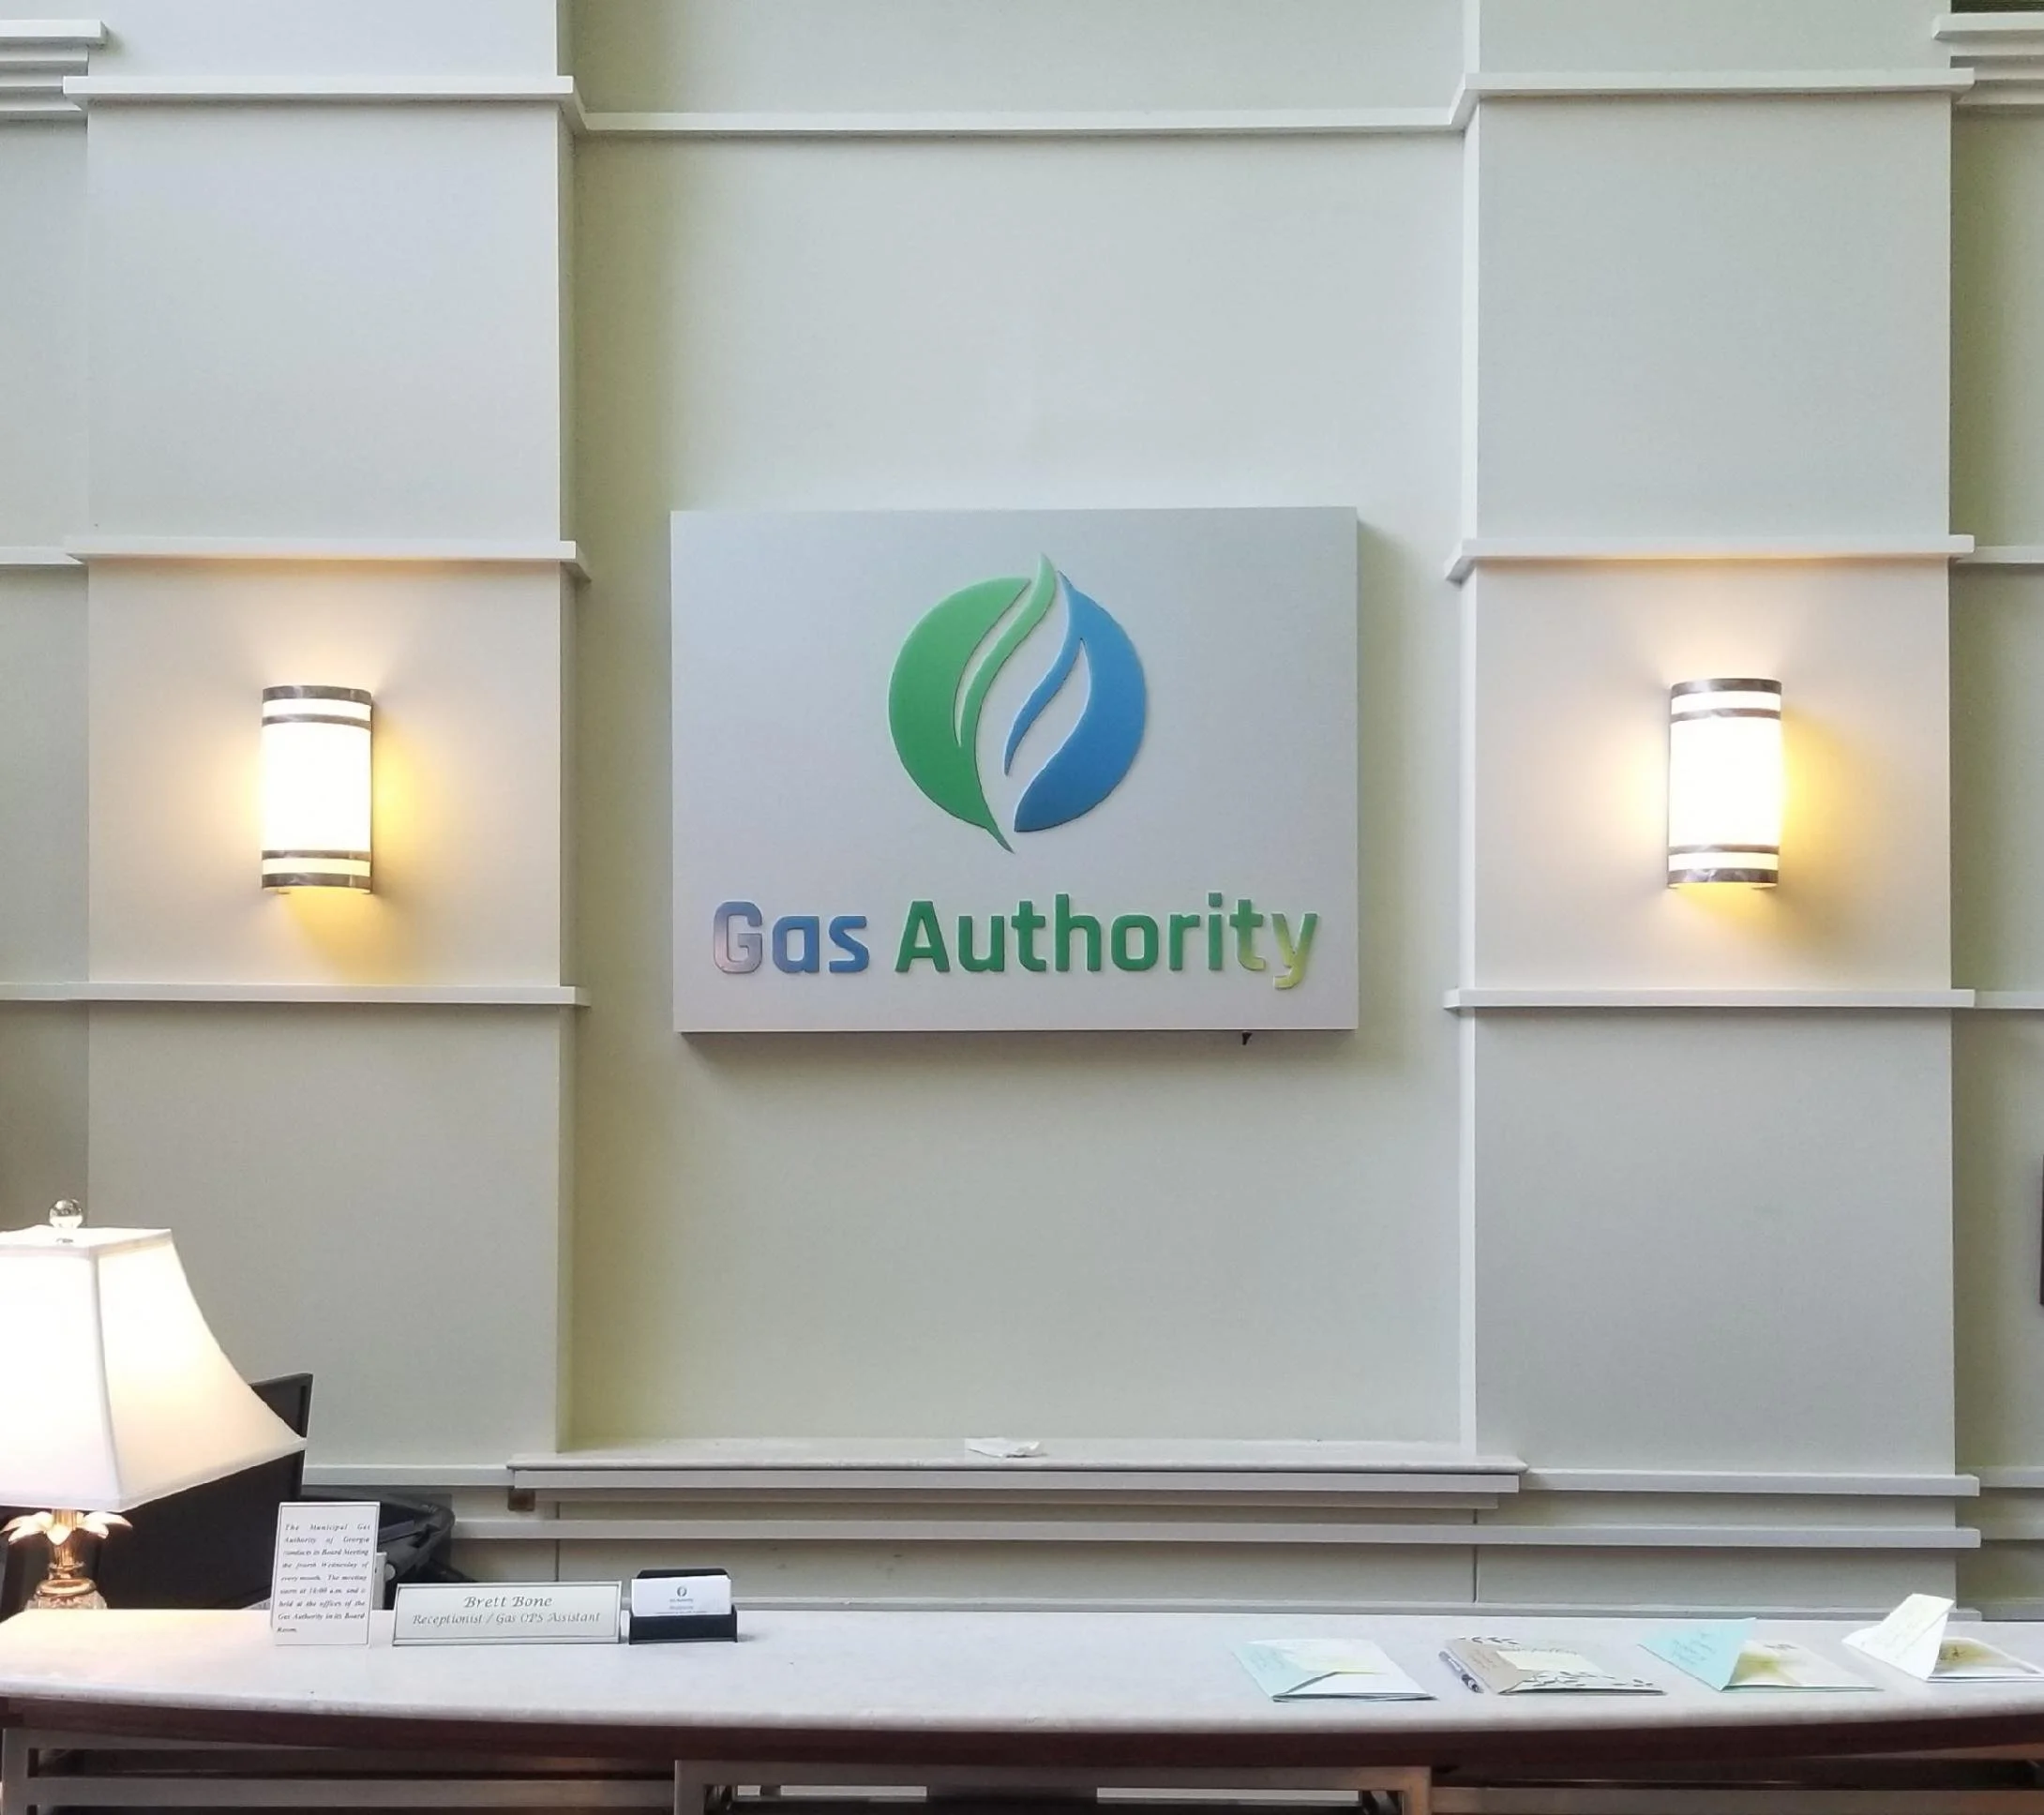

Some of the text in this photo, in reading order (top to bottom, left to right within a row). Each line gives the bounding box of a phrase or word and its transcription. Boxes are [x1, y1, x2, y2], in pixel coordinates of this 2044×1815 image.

[712, 892, 1318, 991] Gas Authority
[463, 1596, 553, 1609] Brett Bone
[413, 1614, 483, 1628] Receptionist
[496, 1613, 516, 1626] Gas
[520, 1612, 544, 1623] OPS
[547, 1612, 602, 1623] Assistant
